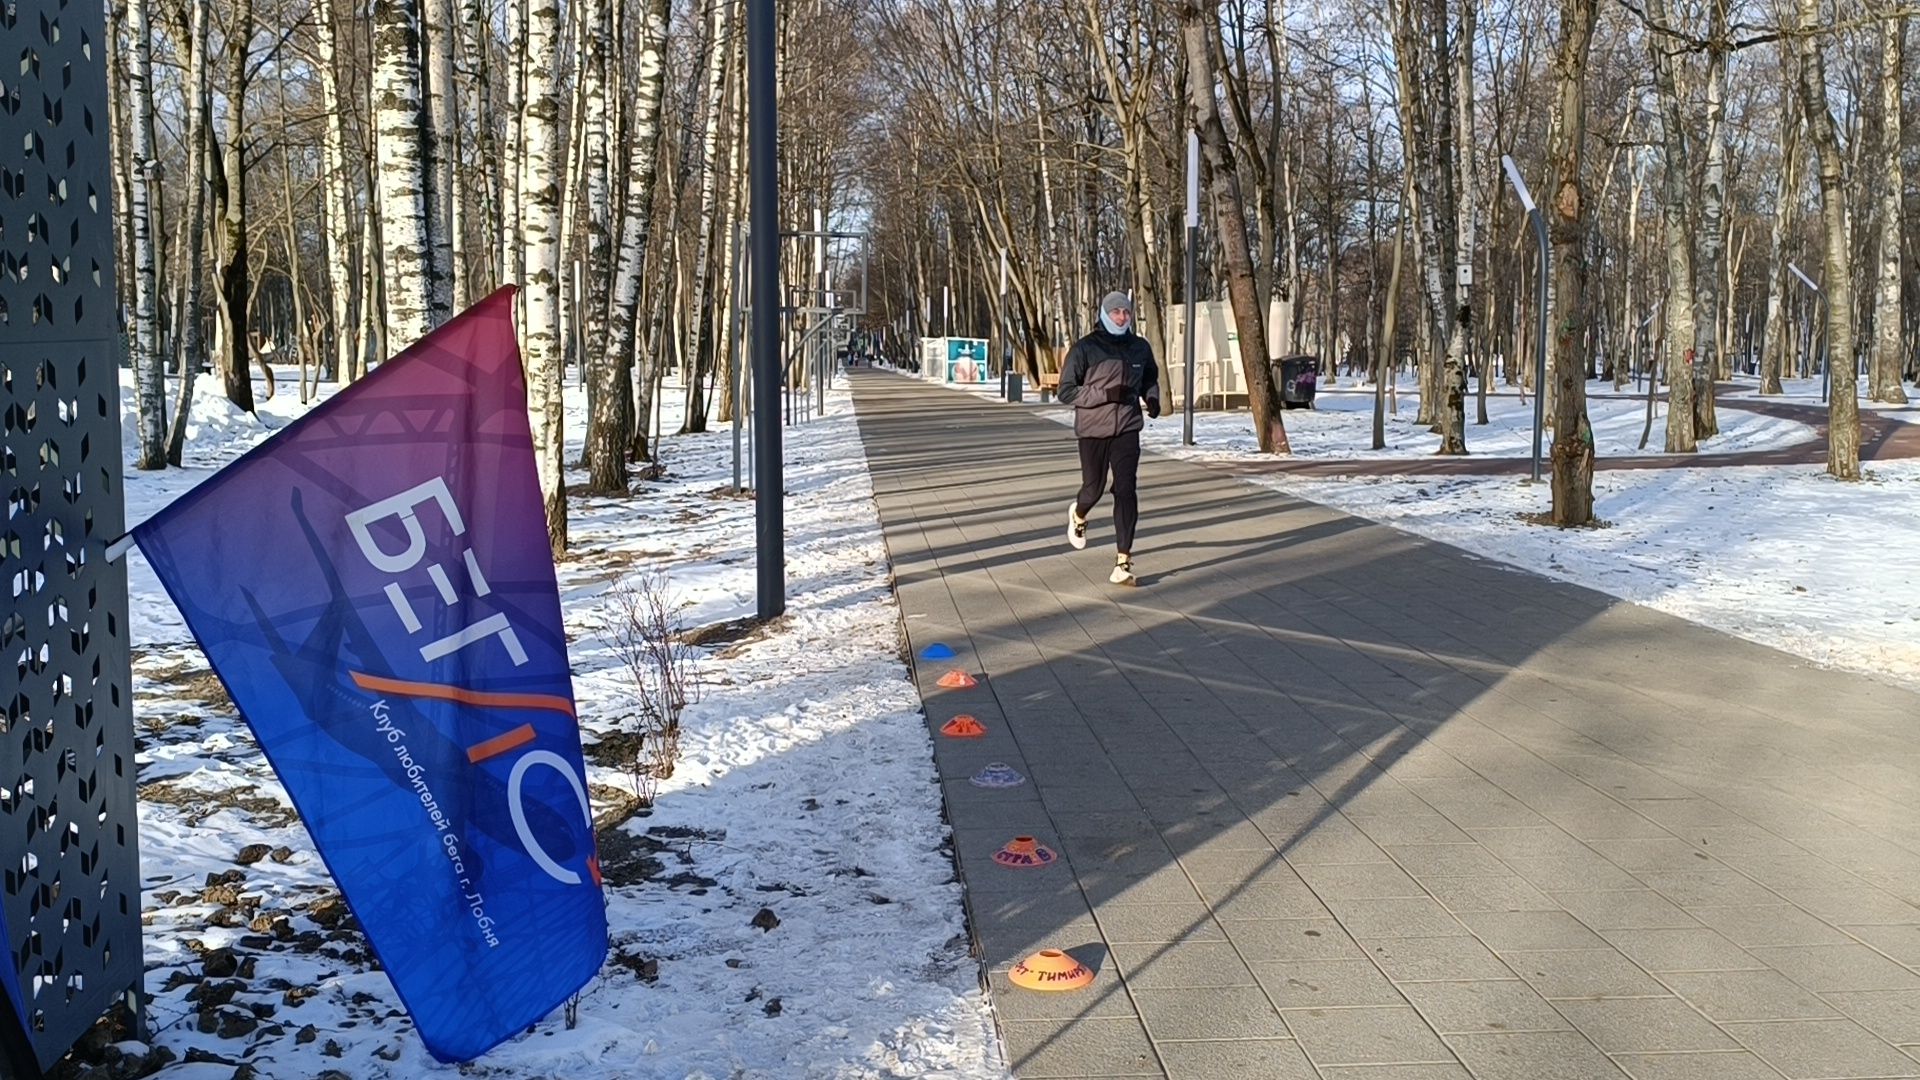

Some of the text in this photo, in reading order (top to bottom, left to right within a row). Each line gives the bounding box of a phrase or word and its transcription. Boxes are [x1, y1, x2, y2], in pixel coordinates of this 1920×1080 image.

[369, 699, 500, 949] Клуб любителей бега г. Лобня
